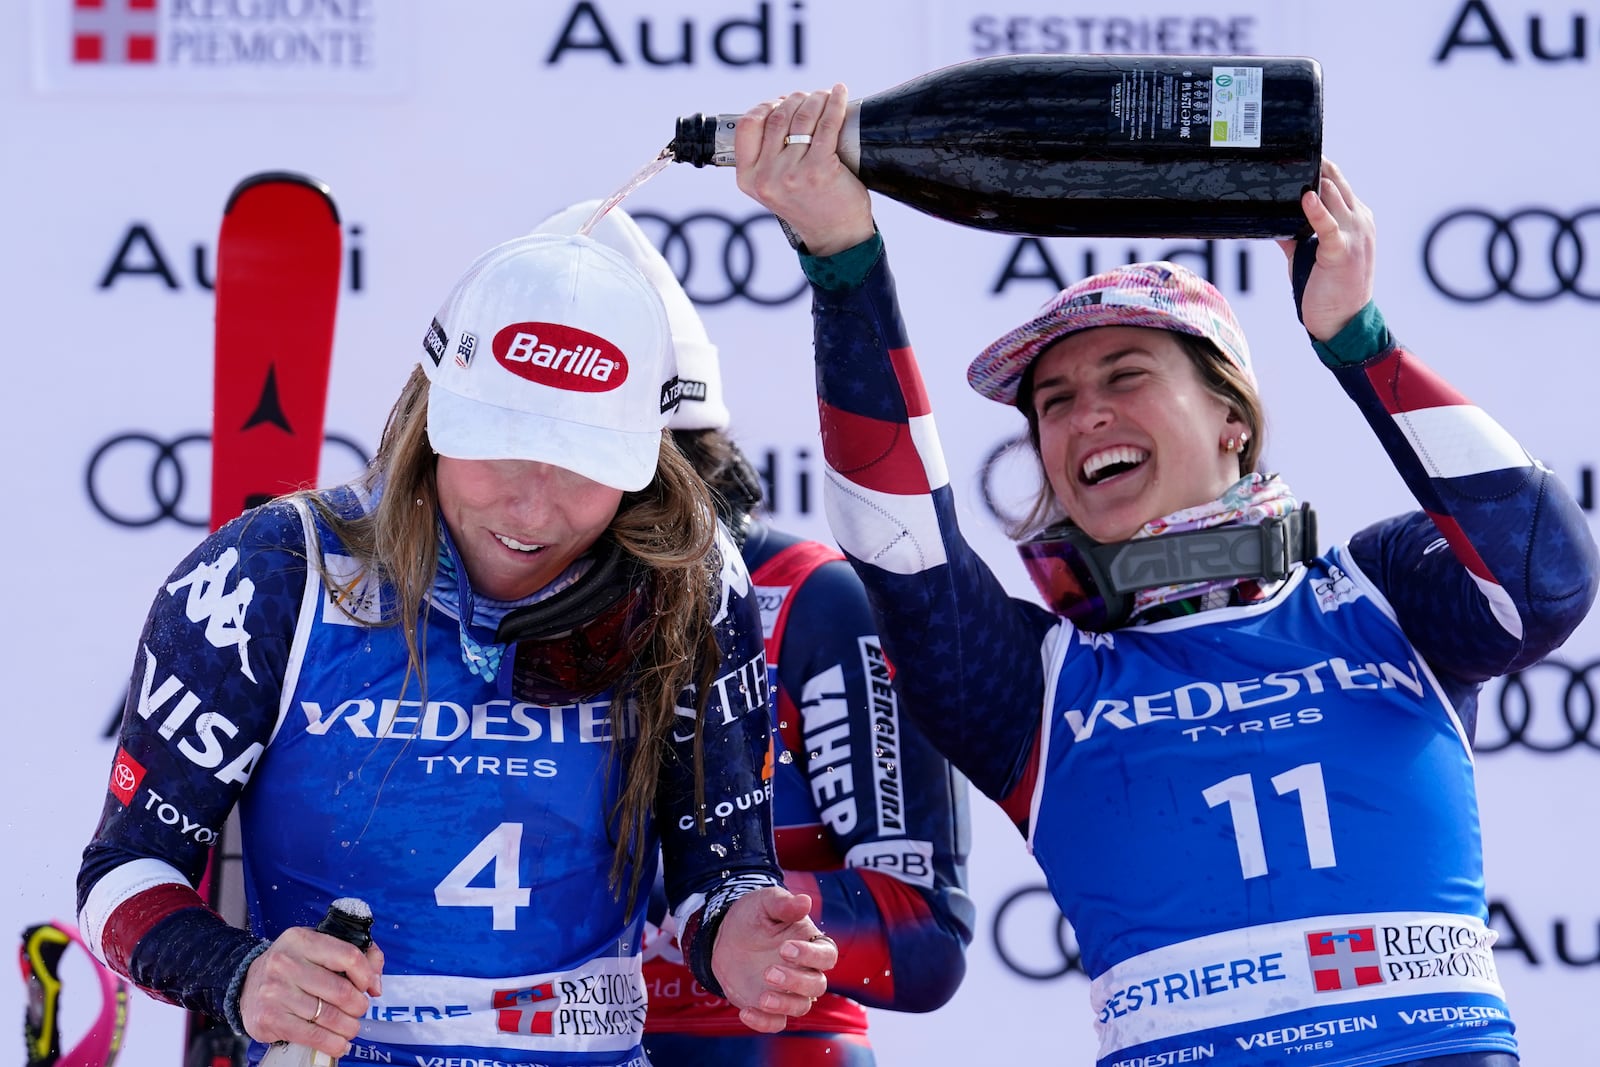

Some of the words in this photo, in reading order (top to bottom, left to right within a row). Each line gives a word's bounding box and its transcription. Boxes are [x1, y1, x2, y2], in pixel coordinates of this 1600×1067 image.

[170, 32, 371, 65] PIEMONTE
[545, 0, 806, 66] Audi
[971, 16, 1254, 54] SESTRIERE
[505, 332, 615, 382] Barilla
[1119, 531, 1284, 585] GIRO
[136, 642, 266, 791] VISA
[1181, 707, 1324, 743] TYRES
[417, 755, 558, 778] TYRES
[1201, 762, 1338, 880] 11
[433, 822, 532, 931] 4
[1235, 1014, 1378, 1051] VREDESTEIN
[1284, 1040, 1335, 1055] TYRES
